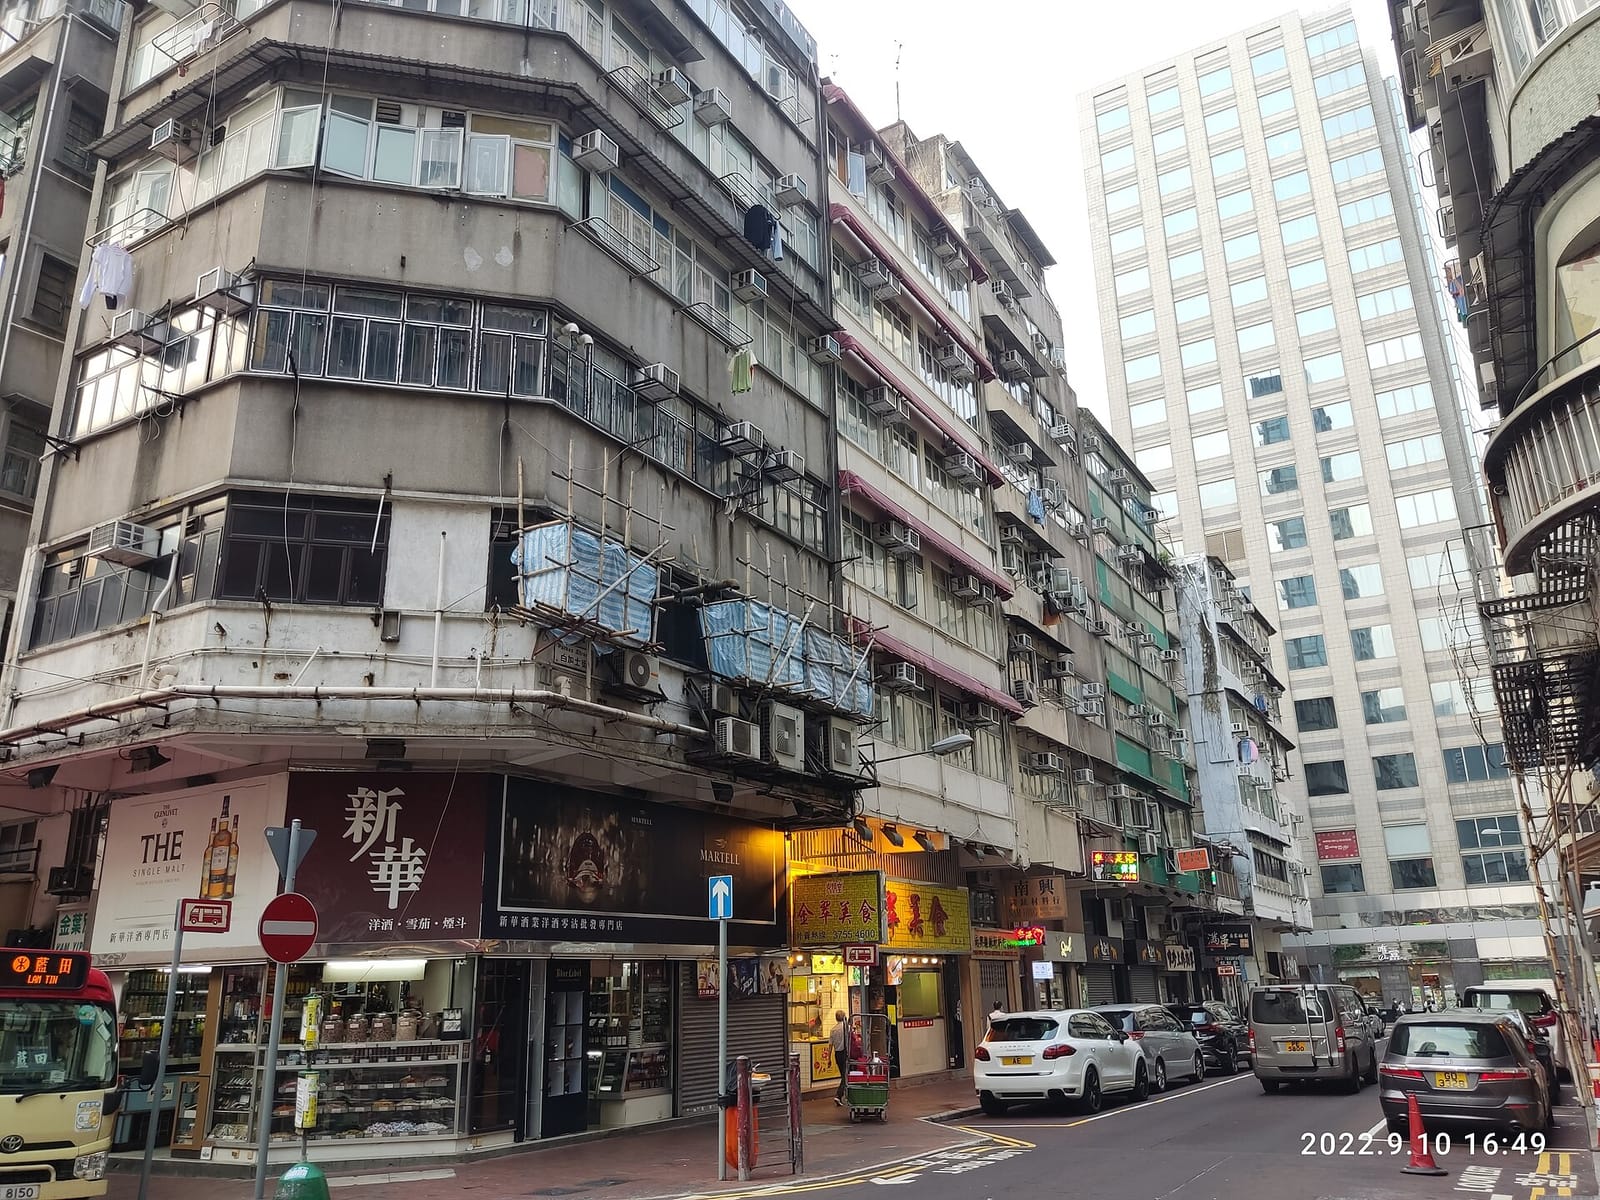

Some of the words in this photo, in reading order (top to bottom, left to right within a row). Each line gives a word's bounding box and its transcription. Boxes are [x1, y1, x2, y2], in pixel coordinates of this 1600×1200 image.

[141, 830, 185, 864] THE
[342, 786, 426, 910] 新華
[700, 849, 740, 865] MARTELL
[132, 866, 161, 877] SINGLE
[165, 863, 186, 873] MALT
[833, 930, 853, 939] 3755
[34, 957, 73, 974] 藍田
[27, 975, 44, 985] LAM
[45, 975, 58, 985] TIN
[16, 1050, 48, 1069] 藍田
[1012, 1057, 1022, 1065] AE
[6, 1187, 34, 1199] 8150
